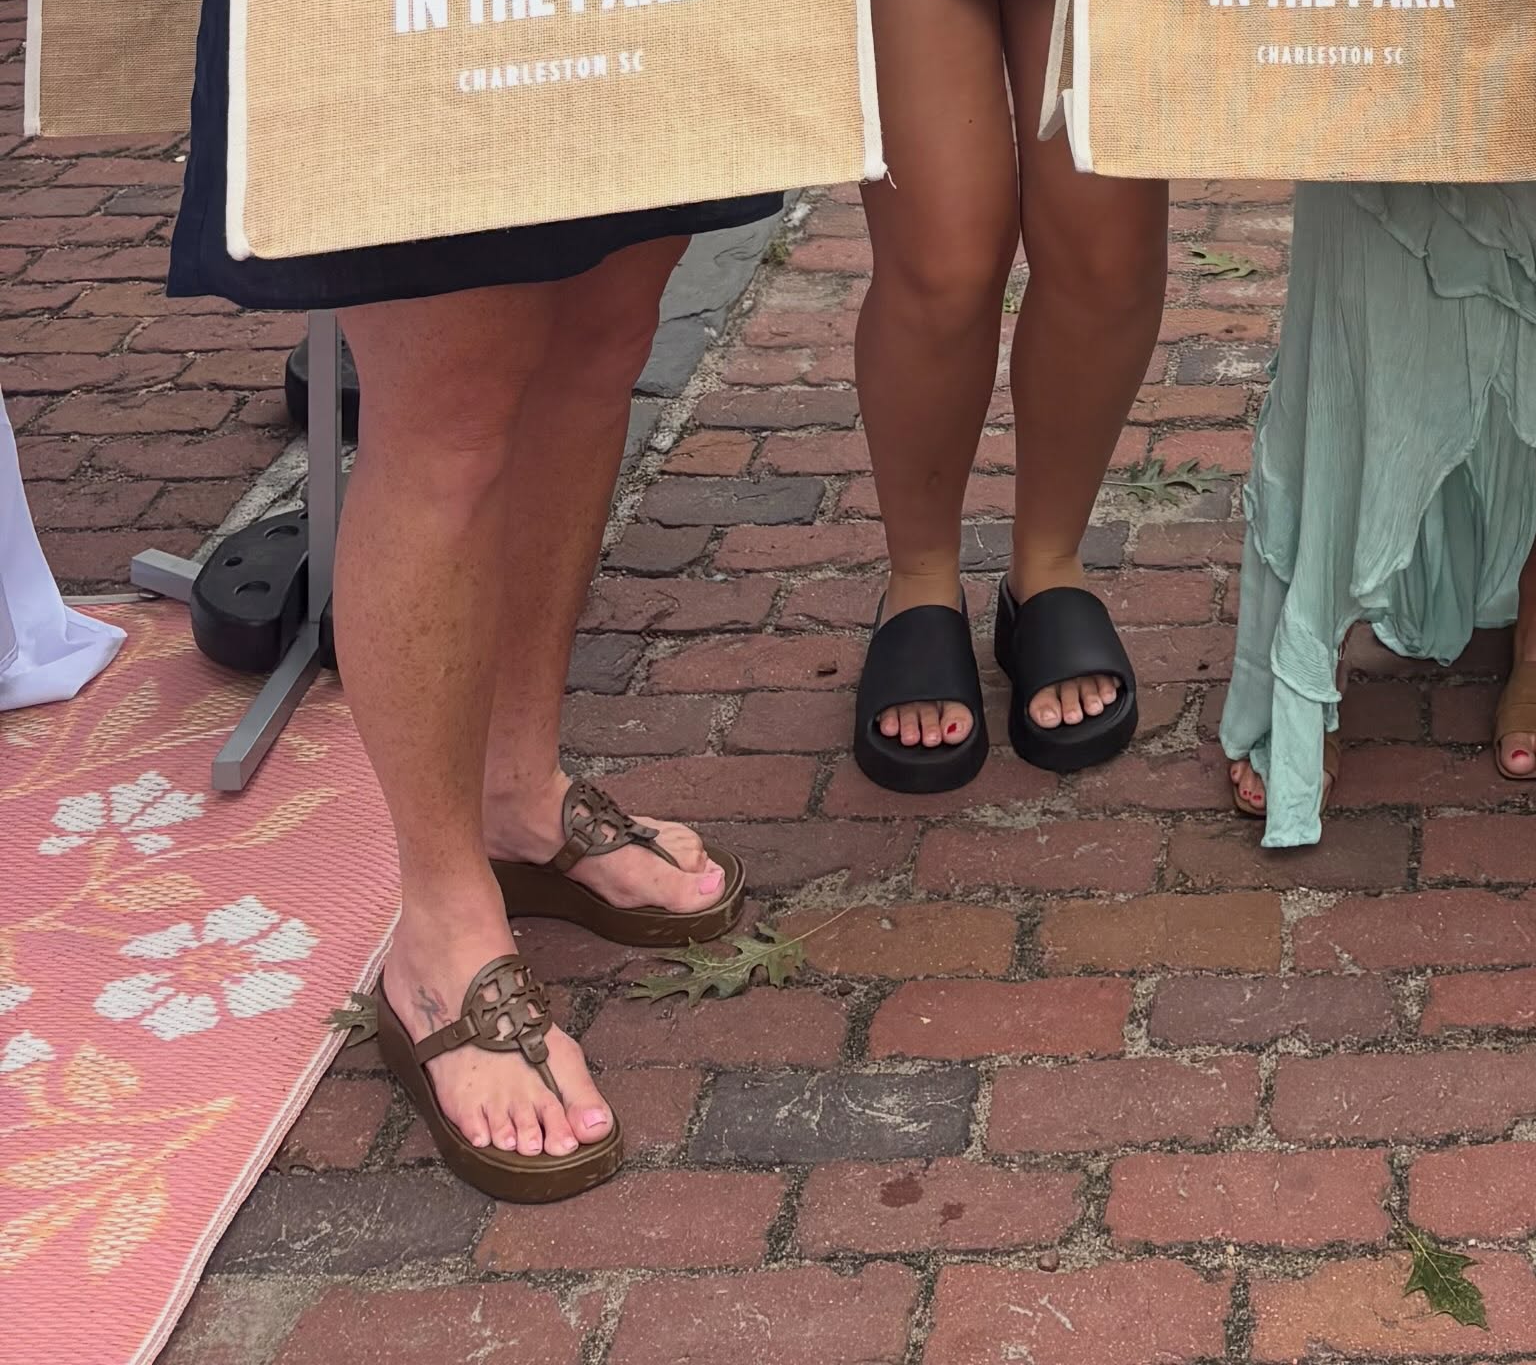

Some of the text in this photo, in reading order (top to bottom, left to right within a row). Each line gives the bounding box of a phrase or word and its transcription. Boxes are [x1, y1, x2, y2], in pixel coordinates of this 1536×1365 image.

[459, 49, 644, 94] CHARLESTON SC
[1257, 45, 1404, 66] CHARLESTON SC
